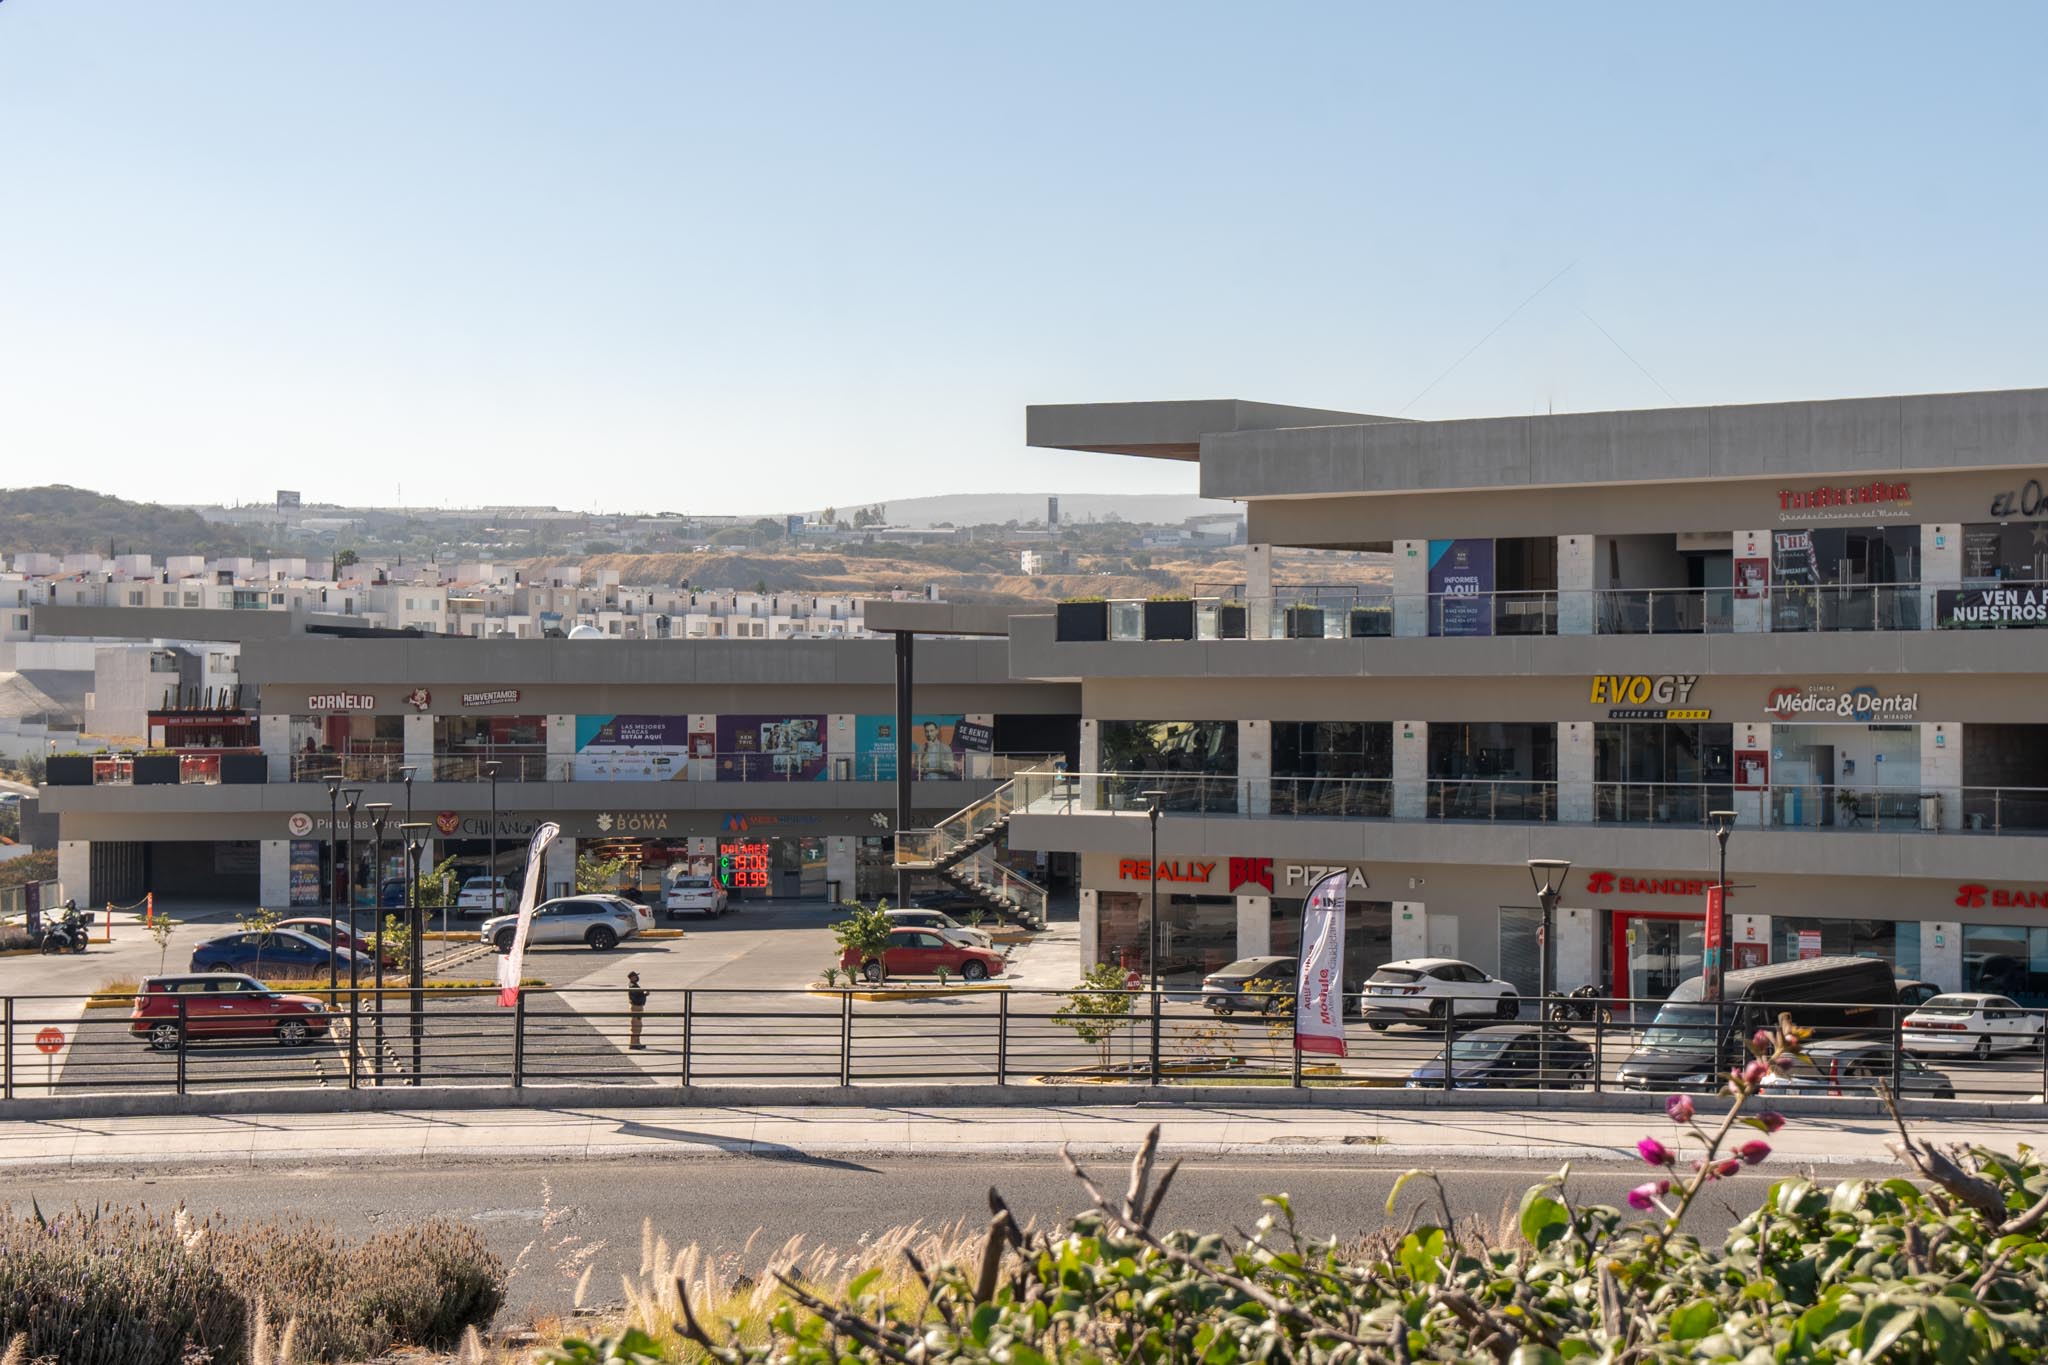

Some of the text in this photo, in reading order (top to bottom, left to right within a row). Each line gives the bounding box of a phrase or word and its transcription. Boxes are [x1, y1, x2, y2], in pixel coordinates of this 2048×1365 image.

[1444, 576, 1479, 584] INFORMES
[1444, 583, 1480, 598] AQUÍ
[1982, 590, 2017, 605] VEN
[2024, 590, 2036, 605] A
[1953, 605, 2047, 621] NUESTROS
[1590, 675, 1699, 704] EVOGY
[309, 692, 375, 710] CORNELIO
[959, 725, 989, 739] SE RENTA
[617, 818, 667, 831] BOMA
[721, 855, 768, 870] C 19.00
[721, 871, 768, 887] V 19.99
[1119, 860, 1215, 882] REALLY
[1229, 857, 1274, 894] BIG
[38, 1036, 62, 1044] ALTO
